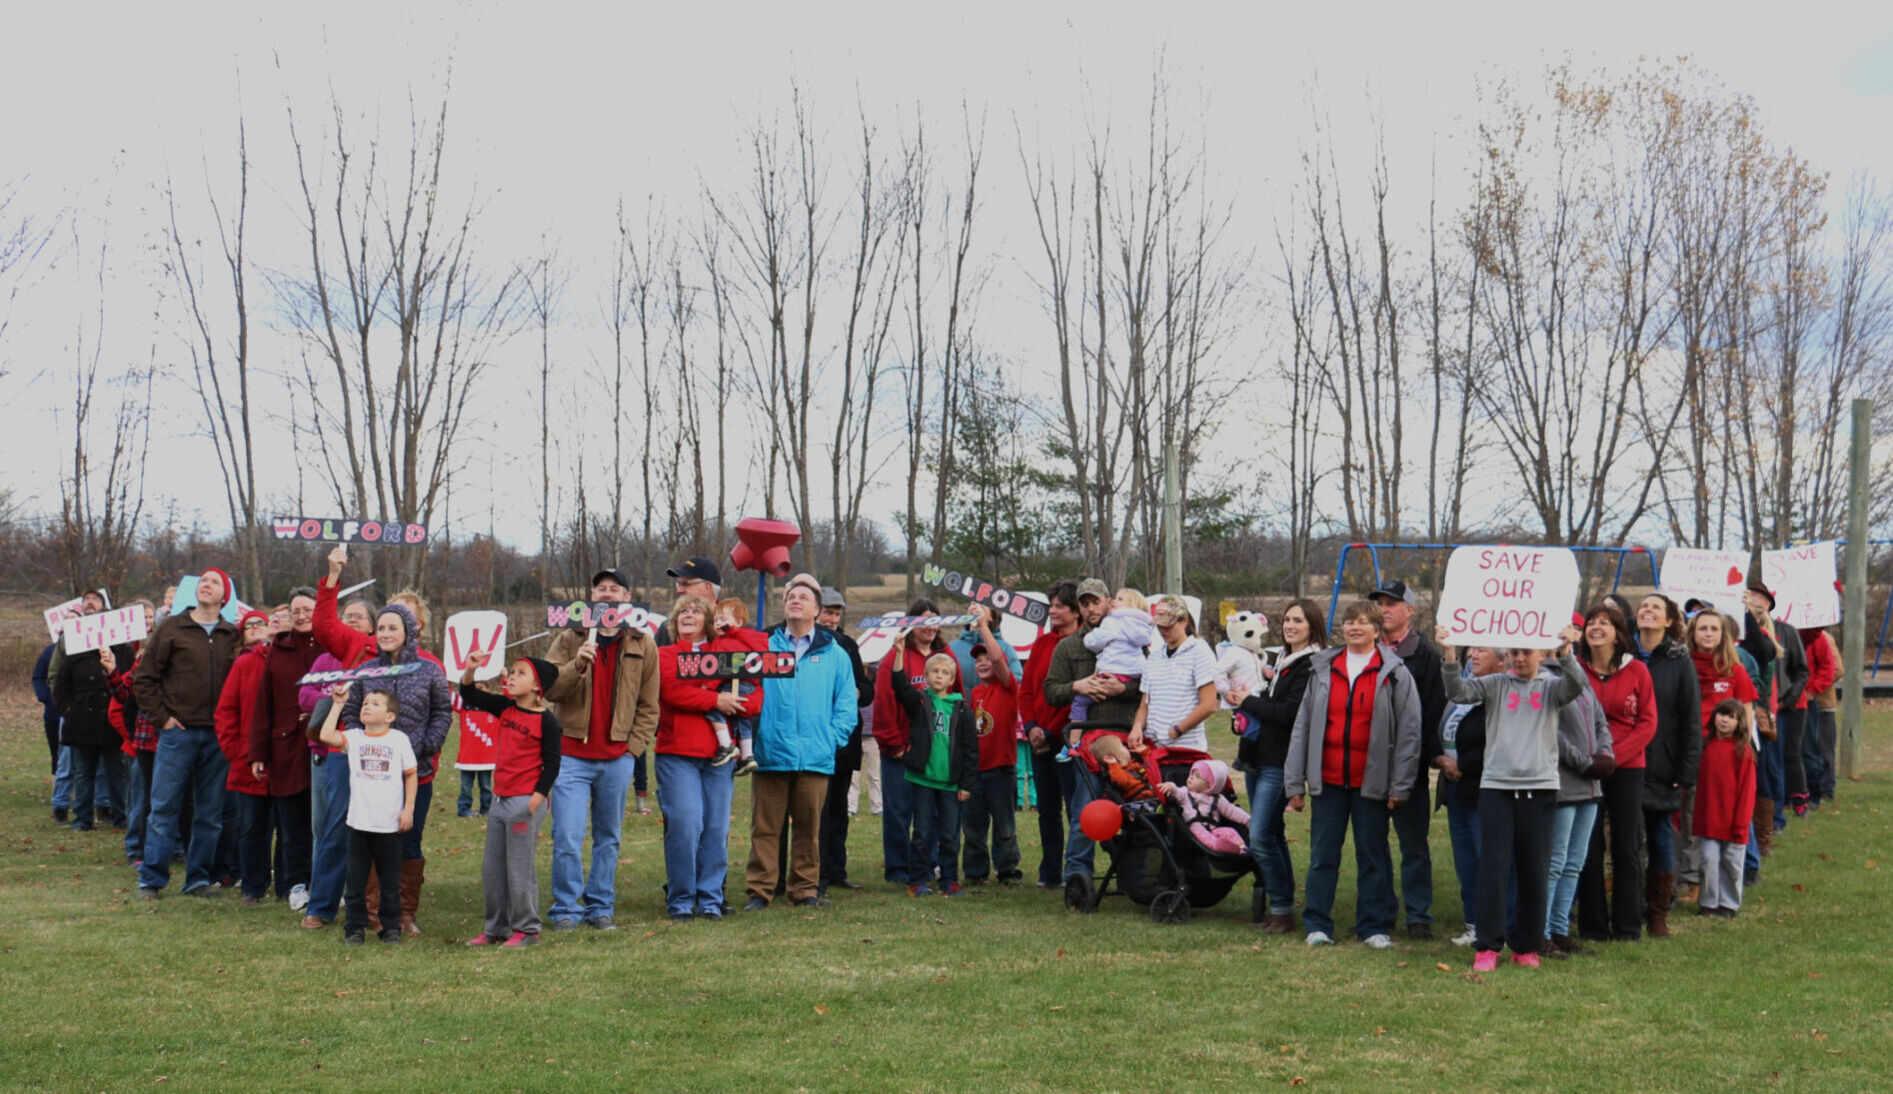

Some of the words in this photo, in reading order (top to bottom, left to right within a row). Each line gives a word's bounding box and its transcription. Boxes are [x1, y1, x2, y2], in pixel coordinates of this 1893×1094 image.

[273, 518, 425, 544] WOLFORD
[1479, 550, 1544, 574] SAVE
[923, 562, 1046, 622] WOLFORD
[1482, 578, 1535, 599] OUR
[858, 614, 975, 629] WOLFORD
[1450, 608, 1553, 639] SCHOOL
[448, 624, 503, 671] W
[301, 662, 422, 684] WOLFORD
[677, 651, 795, 677] WOLFORD
